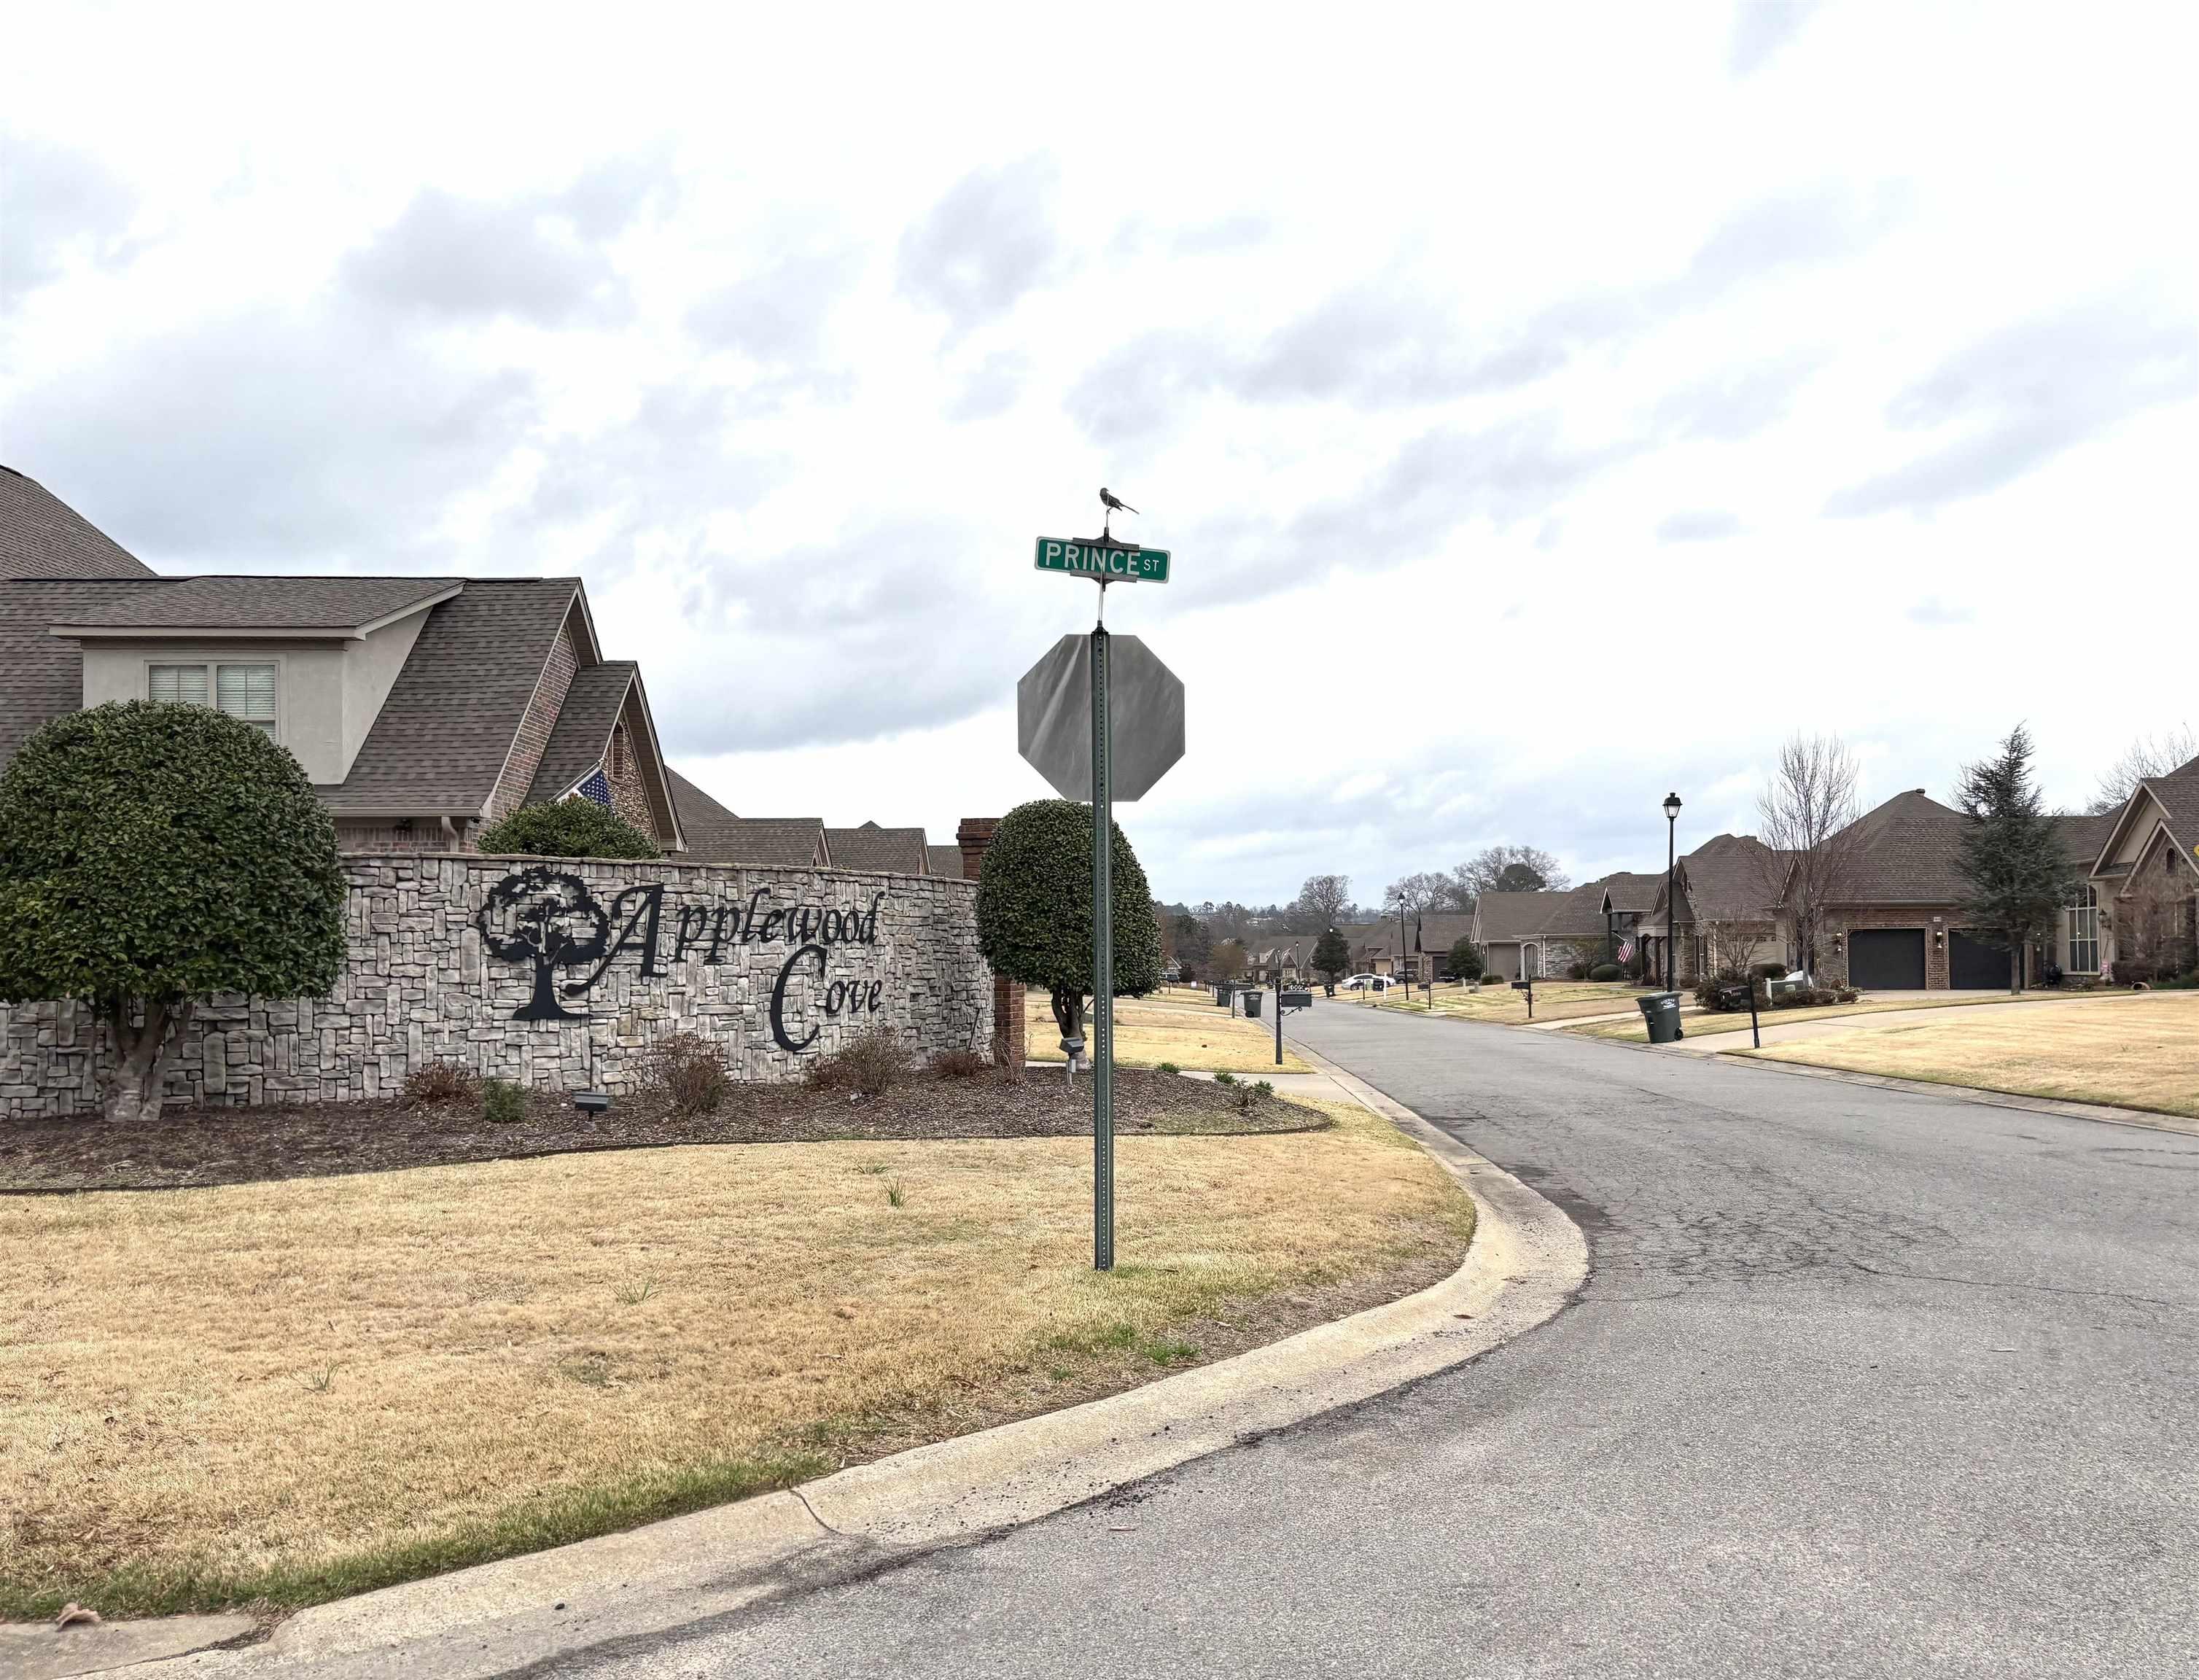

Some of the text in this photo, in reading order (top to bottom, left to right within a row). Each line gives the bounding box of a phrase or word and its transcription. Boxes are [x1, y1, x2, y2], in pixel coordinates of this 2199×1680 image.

[1046, 542, 1159, 576] PRINCE ST
[566, 883, 885, 996] Applewood
[770, 944, 883, 1051] Cove
